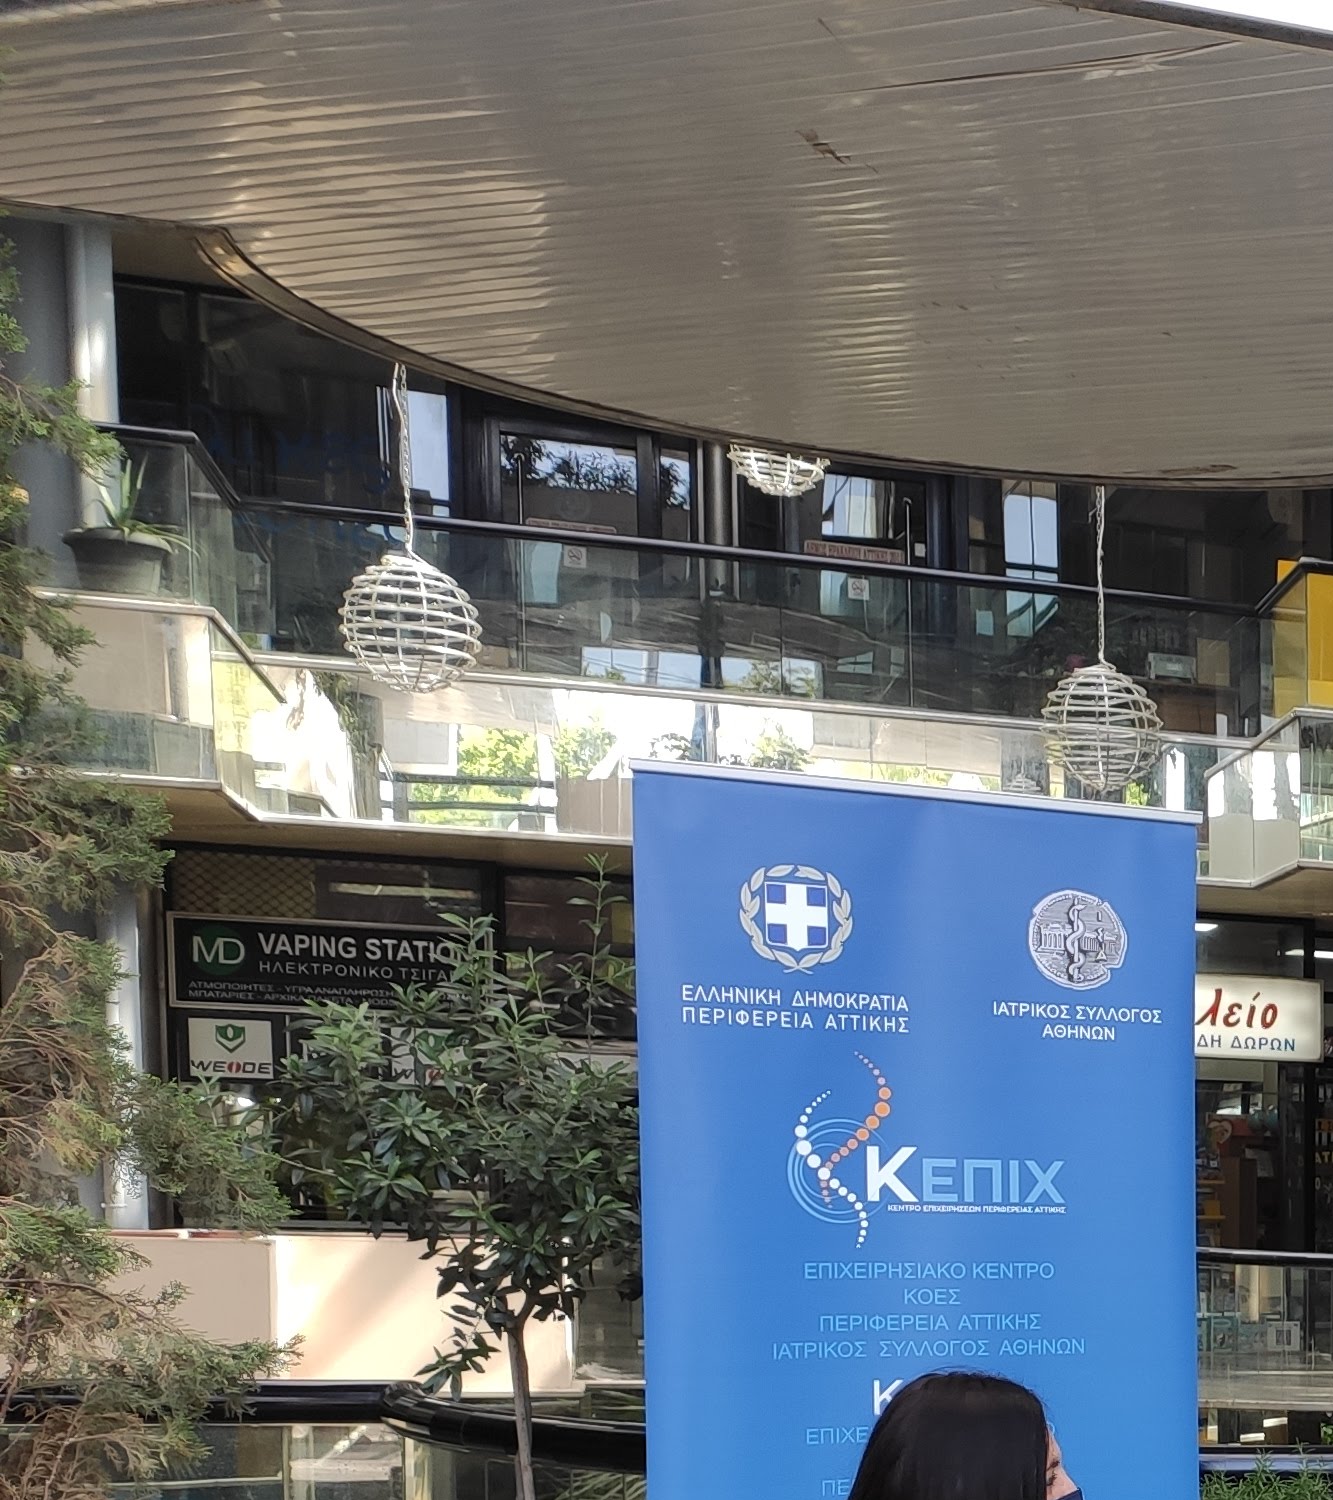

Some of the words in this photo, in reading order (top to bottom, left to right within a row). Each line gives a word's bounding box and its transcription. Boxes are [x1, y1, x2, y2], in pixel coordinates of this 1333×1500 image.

[192, 935, 246, 965] MD
[257, 932, 357, 959] VAPING
[259, 960, 393, 979] ΗΛΕΚΤΡΟΝΙΚΟ
[400, 967, 452, 981] ΤΣΙΓΑ
[316, 987, 395, 997] ΑΝΑΠΛΗΡΩΣΗ
[682, 984, 781, 1006] ΕΛΛΗΝΙΚΗ
[791, 990, 909, 1012] ΔΗΜΟΚΡΑΤΙΑ
[993, 1000, 1071, 1019] ΙΑΤΡΙΚΟΣ
[1075, 1005, 1163, 1024] ΣΥΛΛΟΓΟΣ
[1195, 988, 1279, 1029] λείο
[682, 1007, 814, 1029] ΠΕΡΙΦΕΡΕΙΑ
[825, 1013, 910, 1033] ΑΤΤΙΚΗΣ
[1041, 1023, 1115, 1041] ΑΘΗΝΩΝ
[1197, 1033, 1222, 1048] ΔΗ
[1230, 1035, 1296, 1052] ΔΩΡΩΝ
[866, 1145, 1067, 1204] ΚΕΠΙΧ
[803, 1262, 967, 1279] ΕΠΙΧΕΙΡΗΣΙΑΚΟ
[972, 1262, 1055, 1279] ΚΕΝΤΡΟ
[903, 1288, 961, 1306] ΚΟΕΣ
[819, 1314, 950, 1332] ΠΕΡΙΦΕΡΕΙΑ
[958, 1313, 1042, 1331] ΑΤΤΙΚΗΣ
[773, 1341, 867, 1360] ΙΑΤΡΙΚΟΣ
[879, 1340, 990, 1359] ΣΥΛΛΟΓΟΣ
[999, 1338, 1085, 1357] ΑΘΗΝΩΝ
